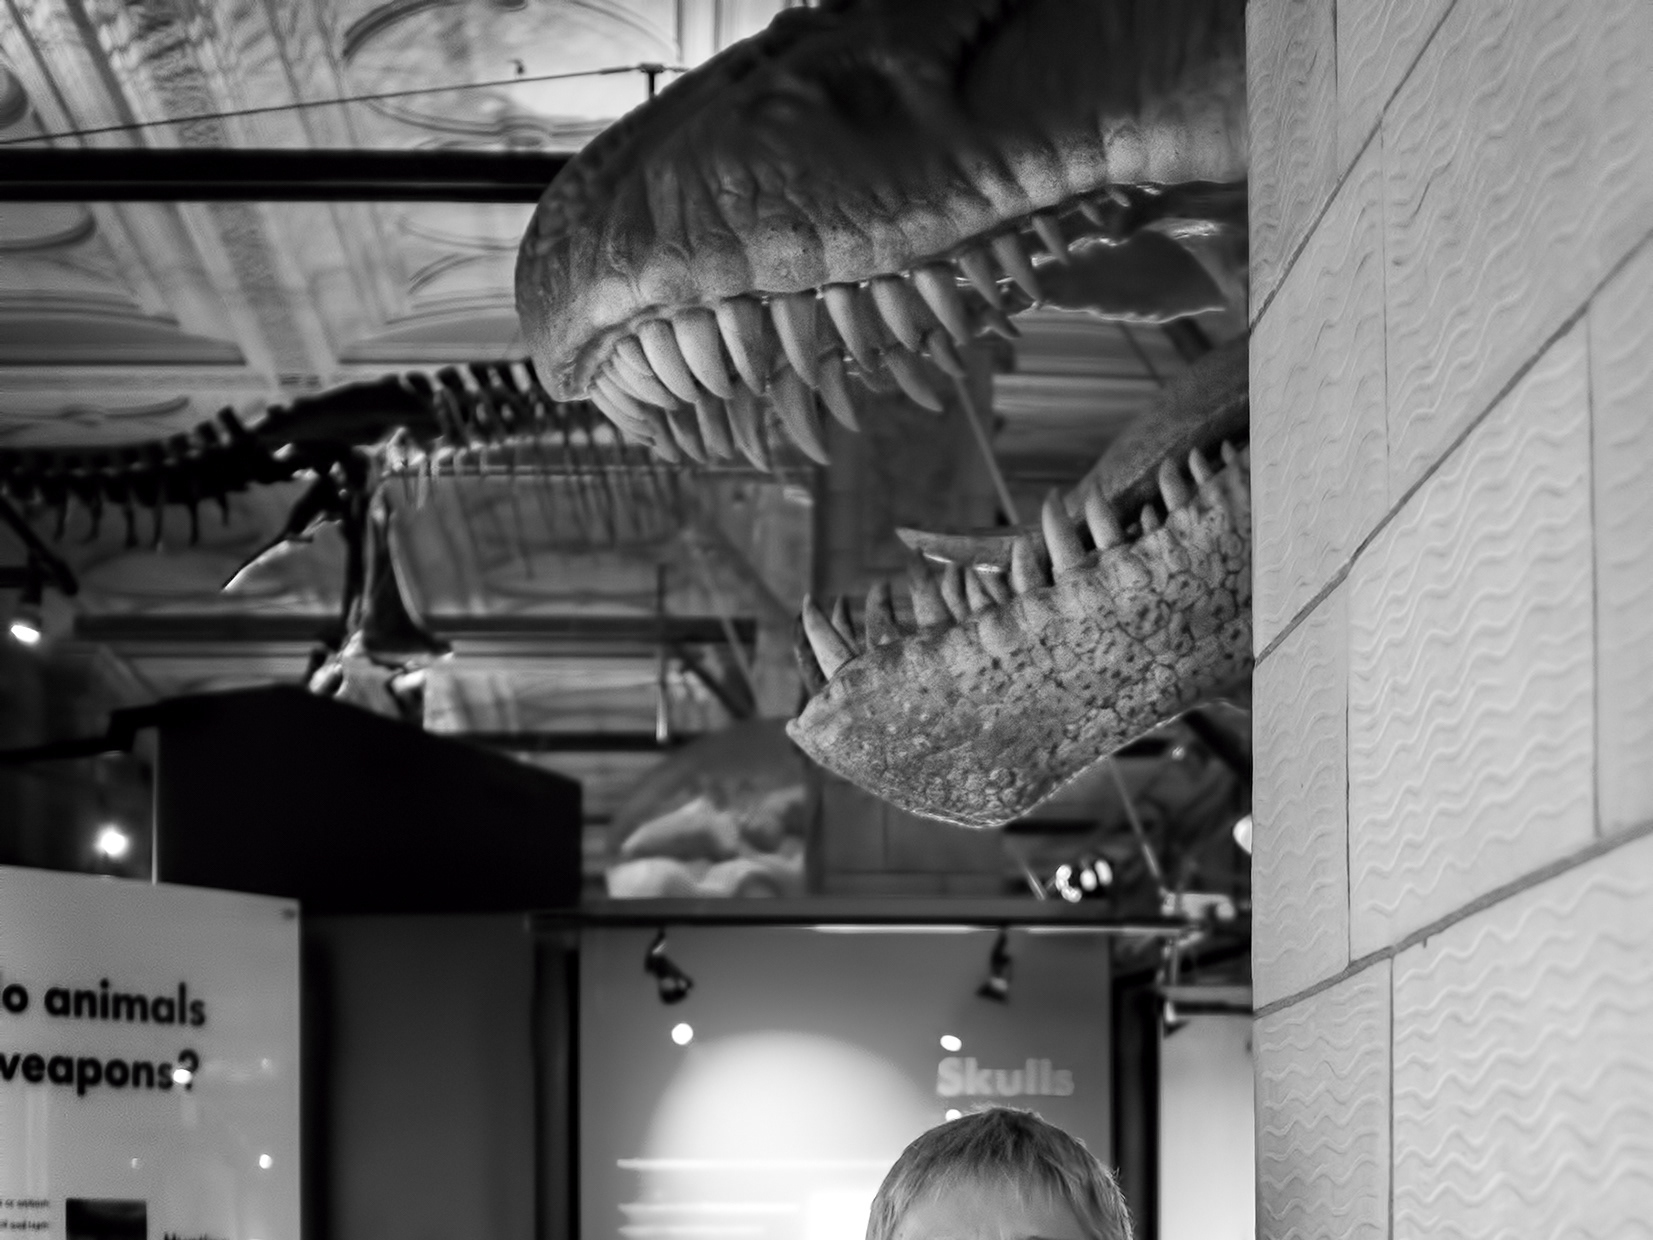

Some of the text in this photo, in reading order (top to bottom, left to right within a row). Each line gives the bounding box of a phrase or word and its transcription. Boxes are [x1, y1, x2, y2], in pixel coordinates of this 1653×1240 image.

[0, 976, 205, 1026] o animals
[937, 1057, 1075, 1096] Skulls
